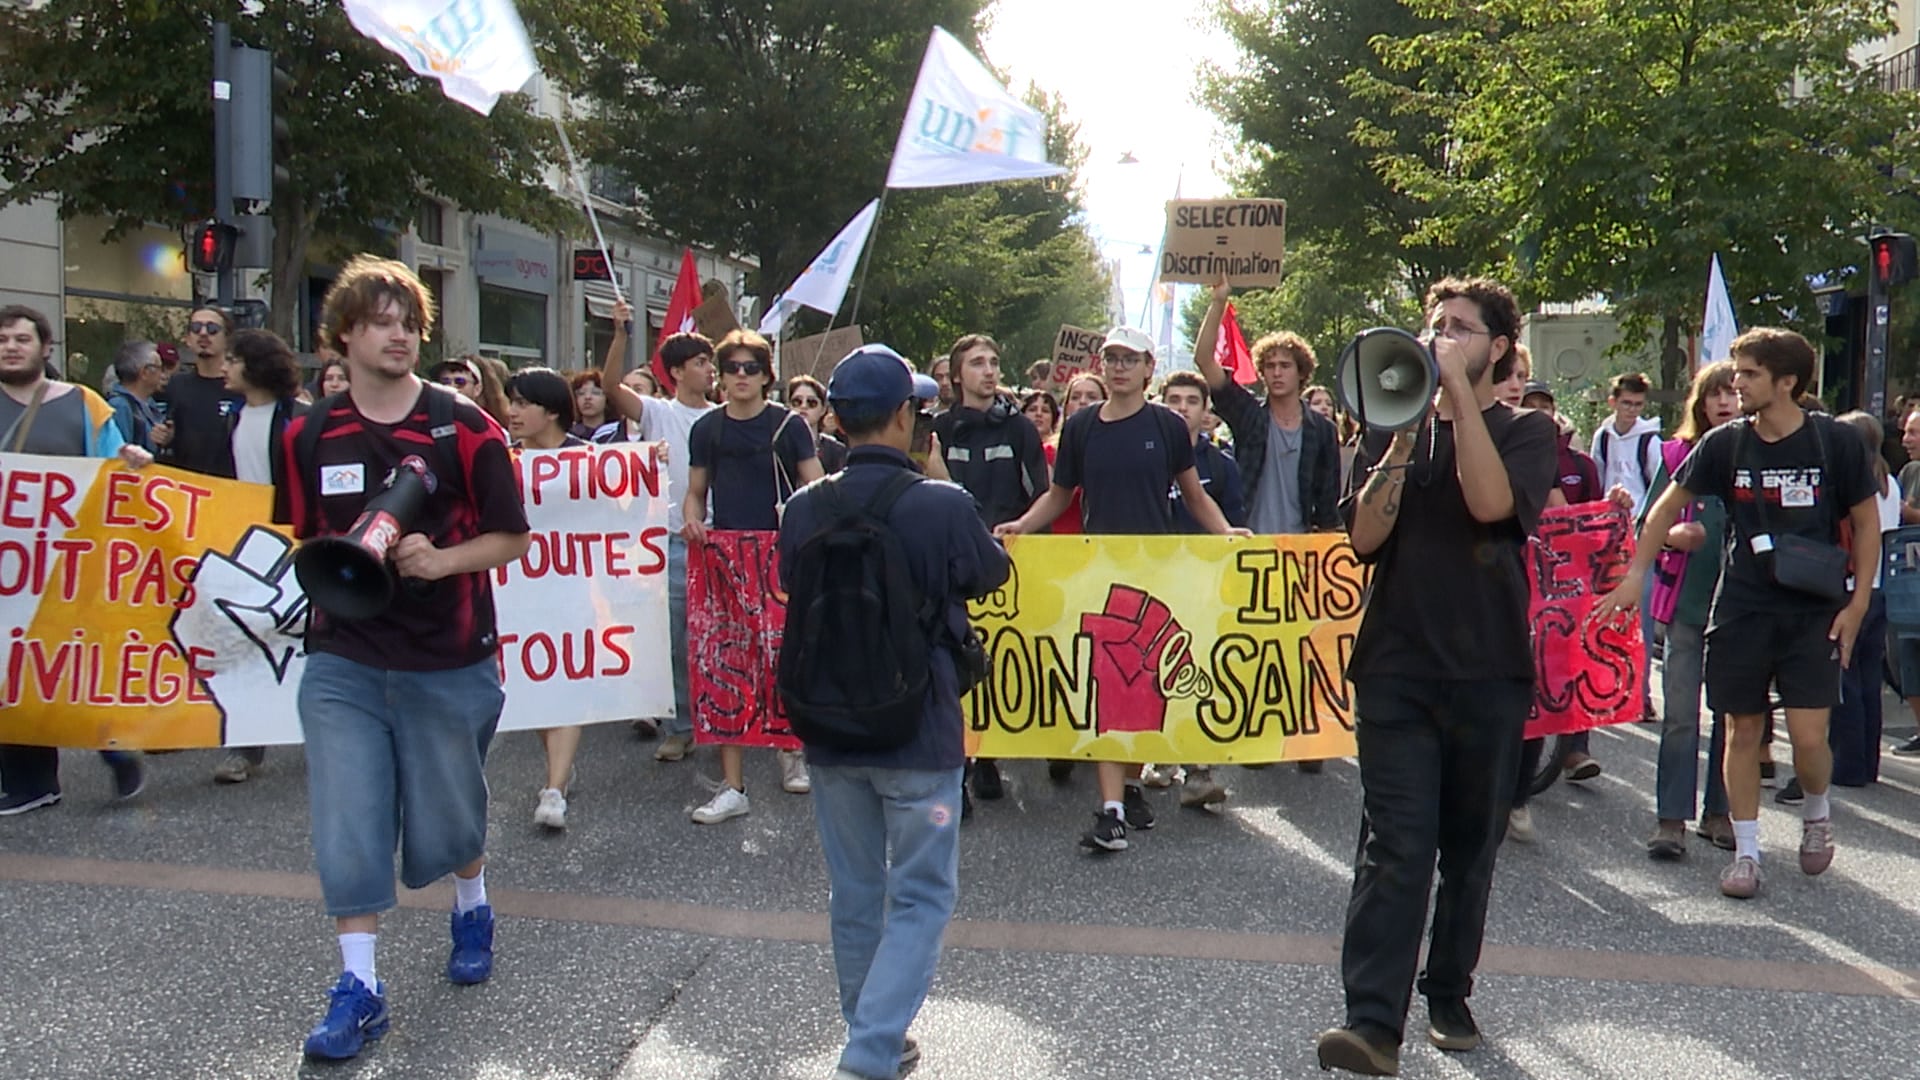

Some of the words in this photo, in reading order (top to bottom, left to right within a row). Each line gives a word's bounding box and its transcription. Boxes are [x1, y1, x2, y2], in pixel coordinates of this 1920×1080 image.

[1163, 251, 1281, 275] Discrimination
[1052, 365, 1086, 383] SA
[0, 471, 76, 528] ER
[105, 473, 212, 538] EST
[107, 541, 200, 609] PAS
[497, 527, 668, 586] OUTES
[1237, 542, 1375, 624] INS
[1528, 511, 1630, 601] EZ
[1528, 606, 1635, 716] CS
